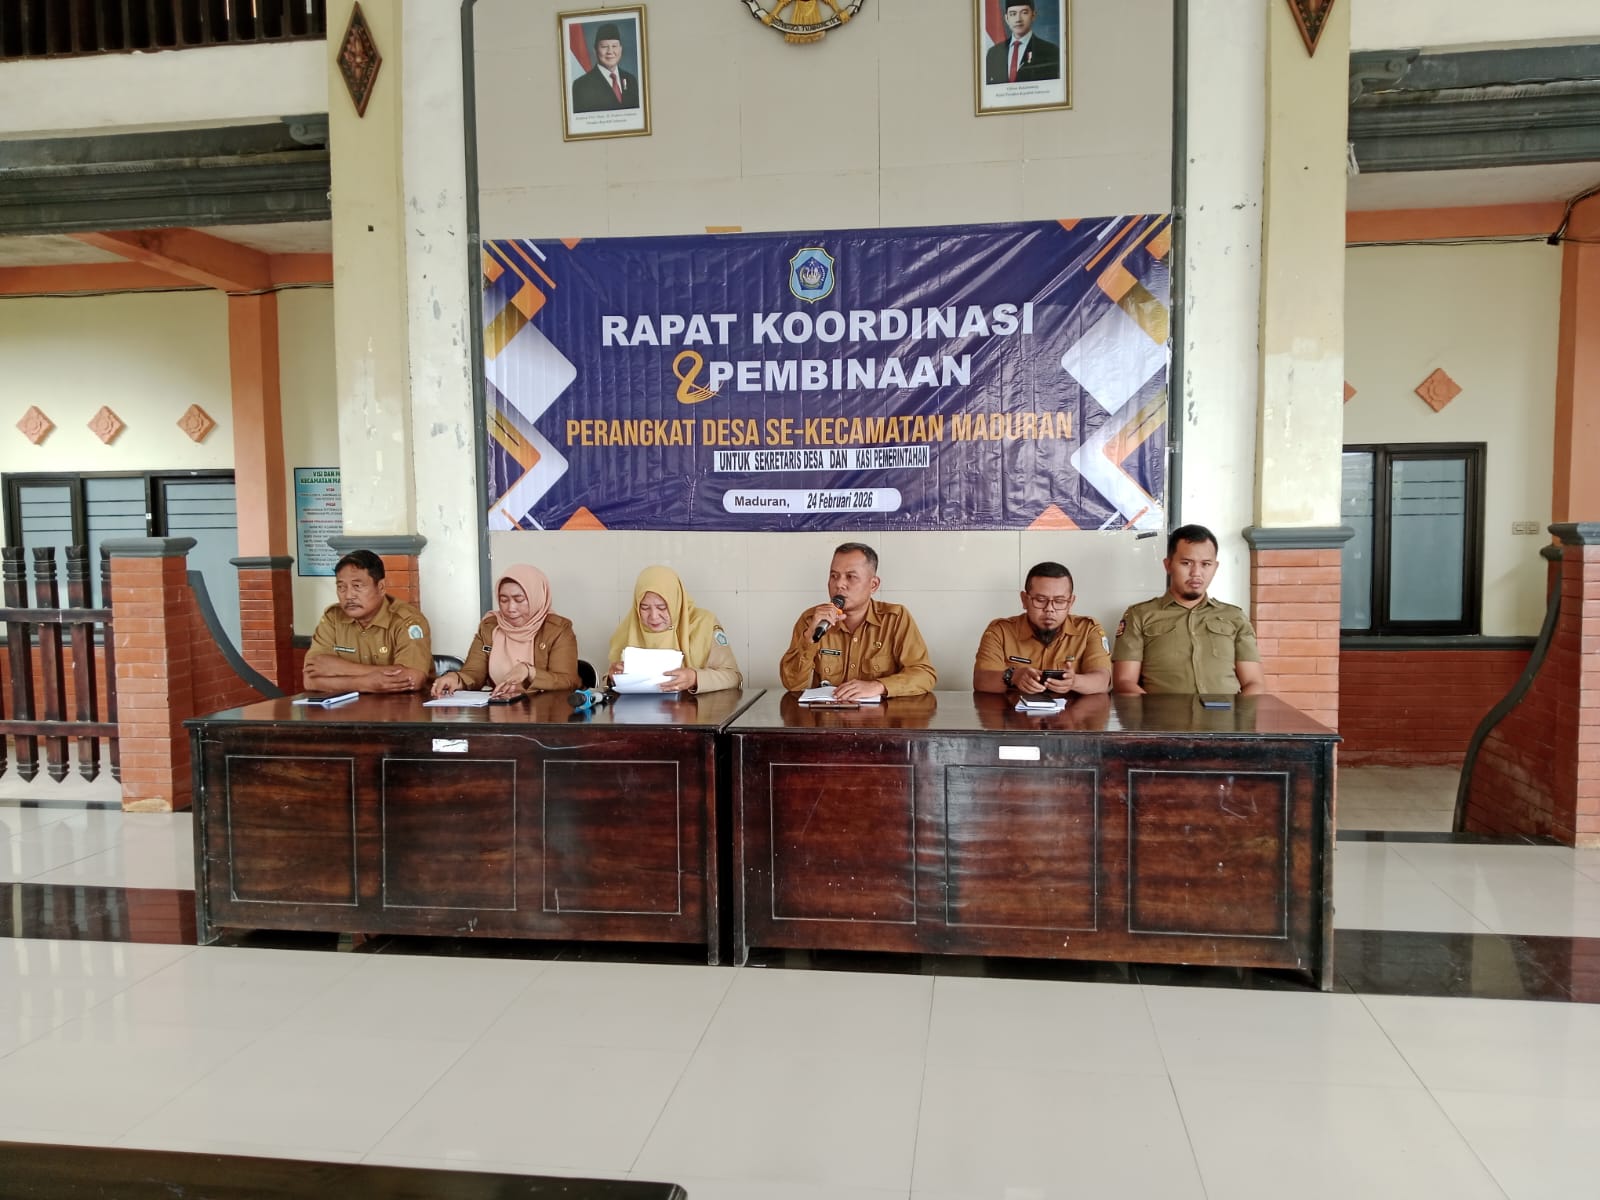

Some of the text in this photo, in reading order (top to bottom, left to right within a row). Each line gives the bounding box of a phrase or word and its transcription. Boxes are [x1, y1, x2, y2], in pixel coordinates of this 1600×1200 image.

[602, 302, 1034, 346] RAPAT KOORDINASI
[709, 354, 971, 392] PEMBINAAN
[566, 412, 1072, 446] PERANGKAT DESA SE-KECAMATAN MADURAN
[719, 447, 928, 471] UNTUK SEKRETARIS DESA DAN KASI PEMERINTAHAN
[734, 491, 874, 509] Maduran, 24 Februari 2026
